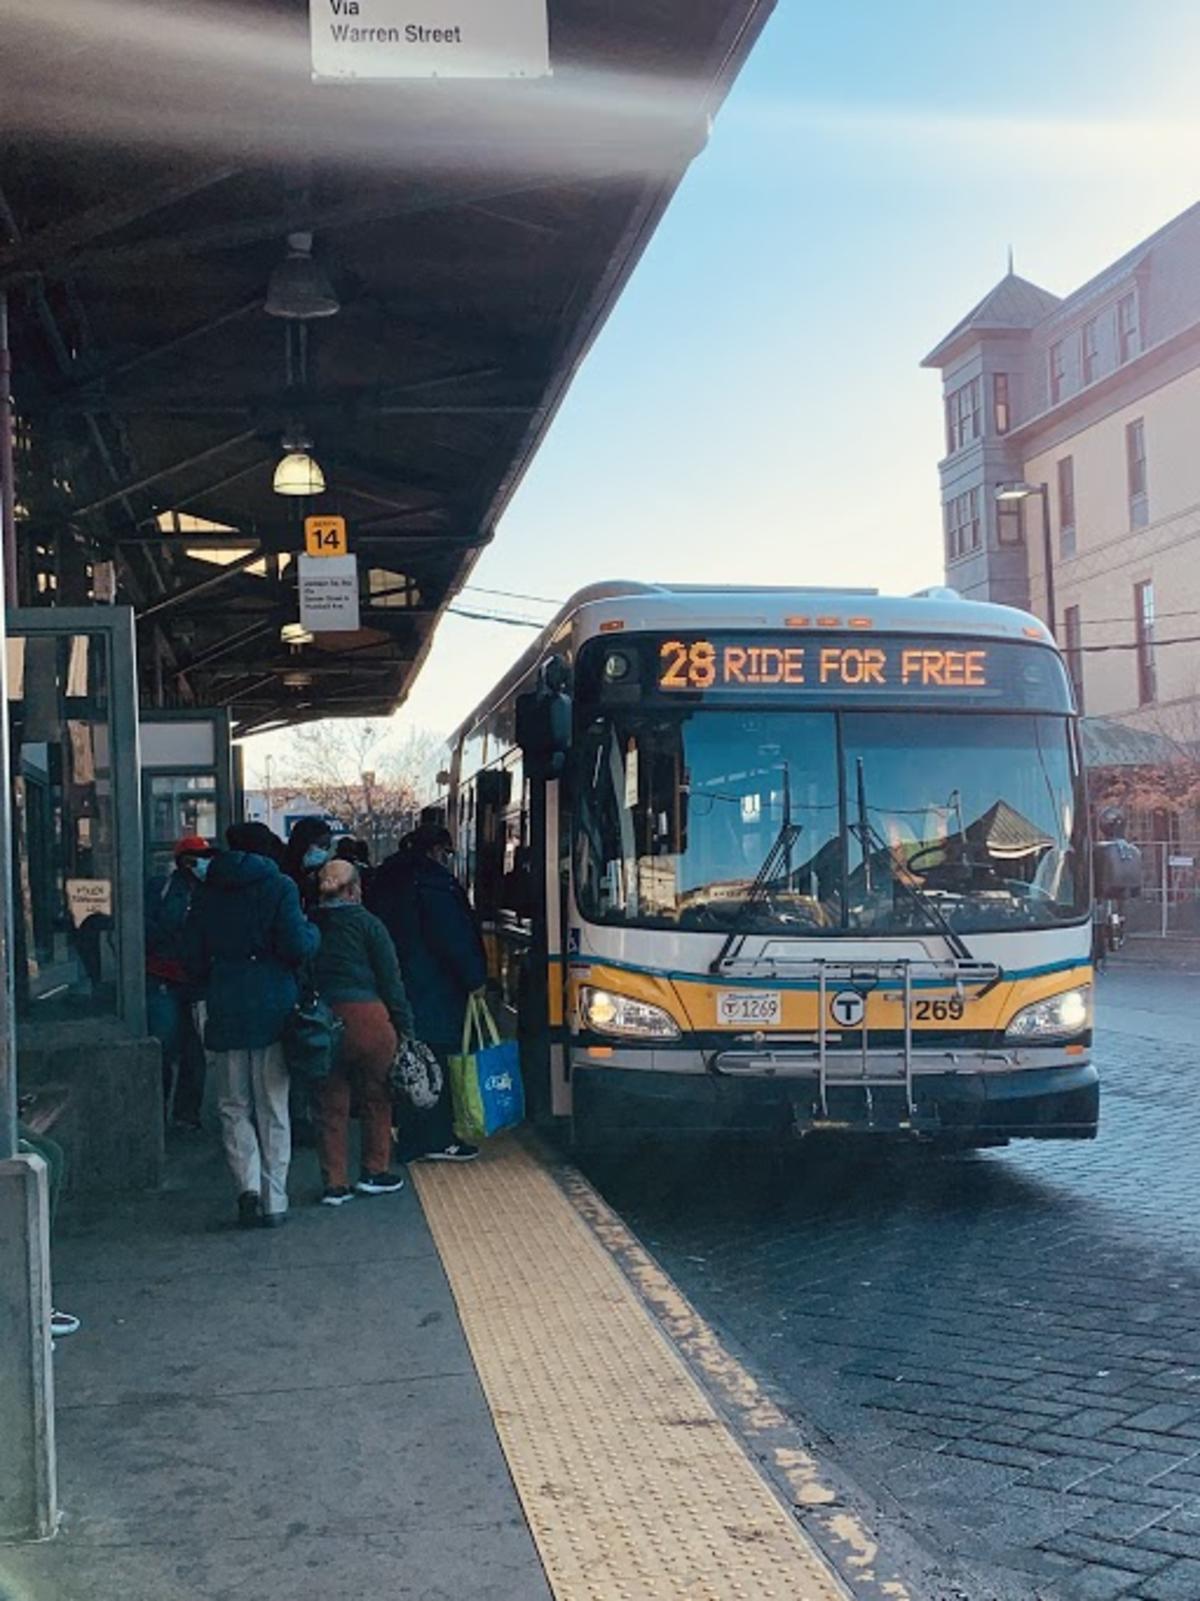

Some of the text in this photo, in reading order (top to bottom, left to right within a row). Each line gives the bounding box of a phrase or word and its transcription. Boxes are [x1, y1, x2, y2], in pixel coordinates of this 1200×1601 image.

[330, 0, 359, 15] Via
[330, 24, 462, 43] Warren Street
[312, 529, 340, 549] 14
[660, 641, 986, 688] 28 RIDE FOR FREE
[742, 1000, 777, 1018] 1269
